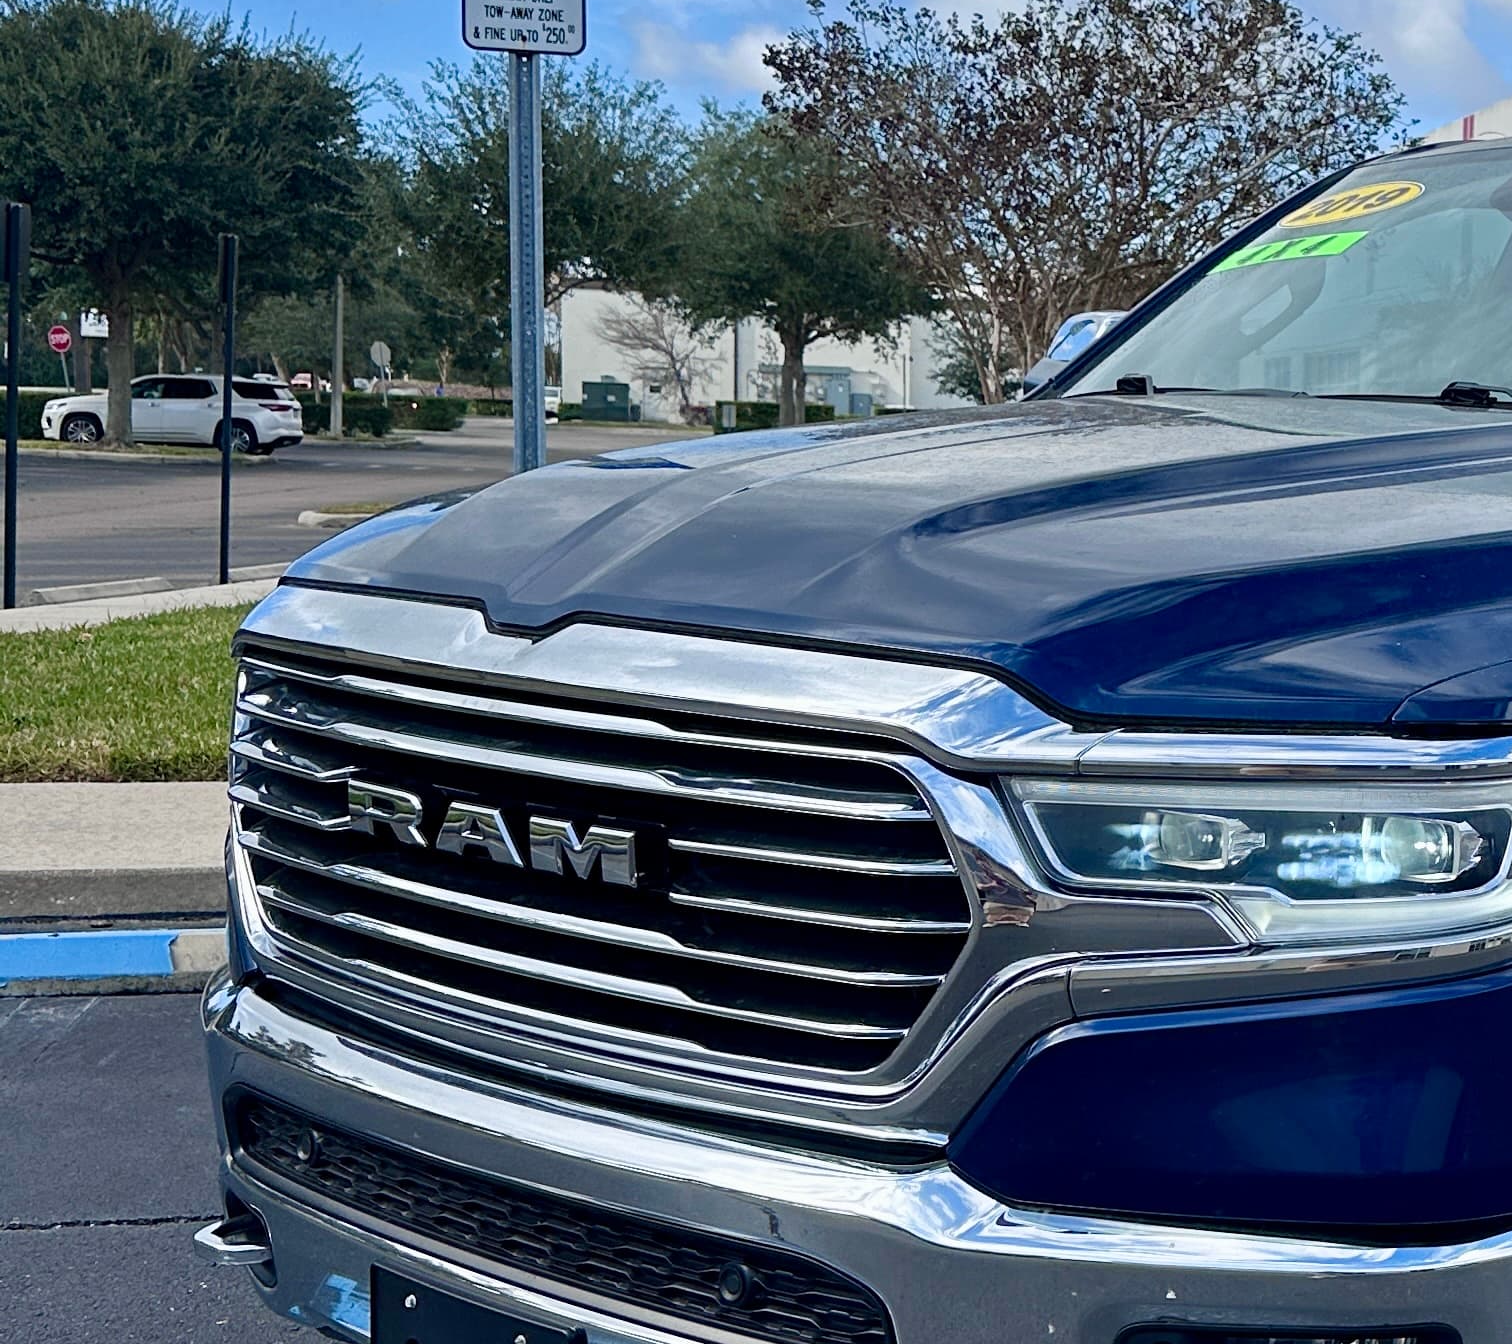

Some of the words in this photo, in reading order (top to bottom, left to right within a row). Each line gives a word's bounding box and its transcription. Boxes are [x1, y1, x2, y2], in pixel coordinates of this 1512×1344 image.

[484, 4, 534, 21] TOW-AWAY
[538, 8, 565, 22] ZONE
[473, 26, 480, 39] &
[485, 27, 506, 40] FINE
[510, 29, 523, 42] UP
[527, 30, 539, 43] TO
[348, 778, 638, 888] RAM
